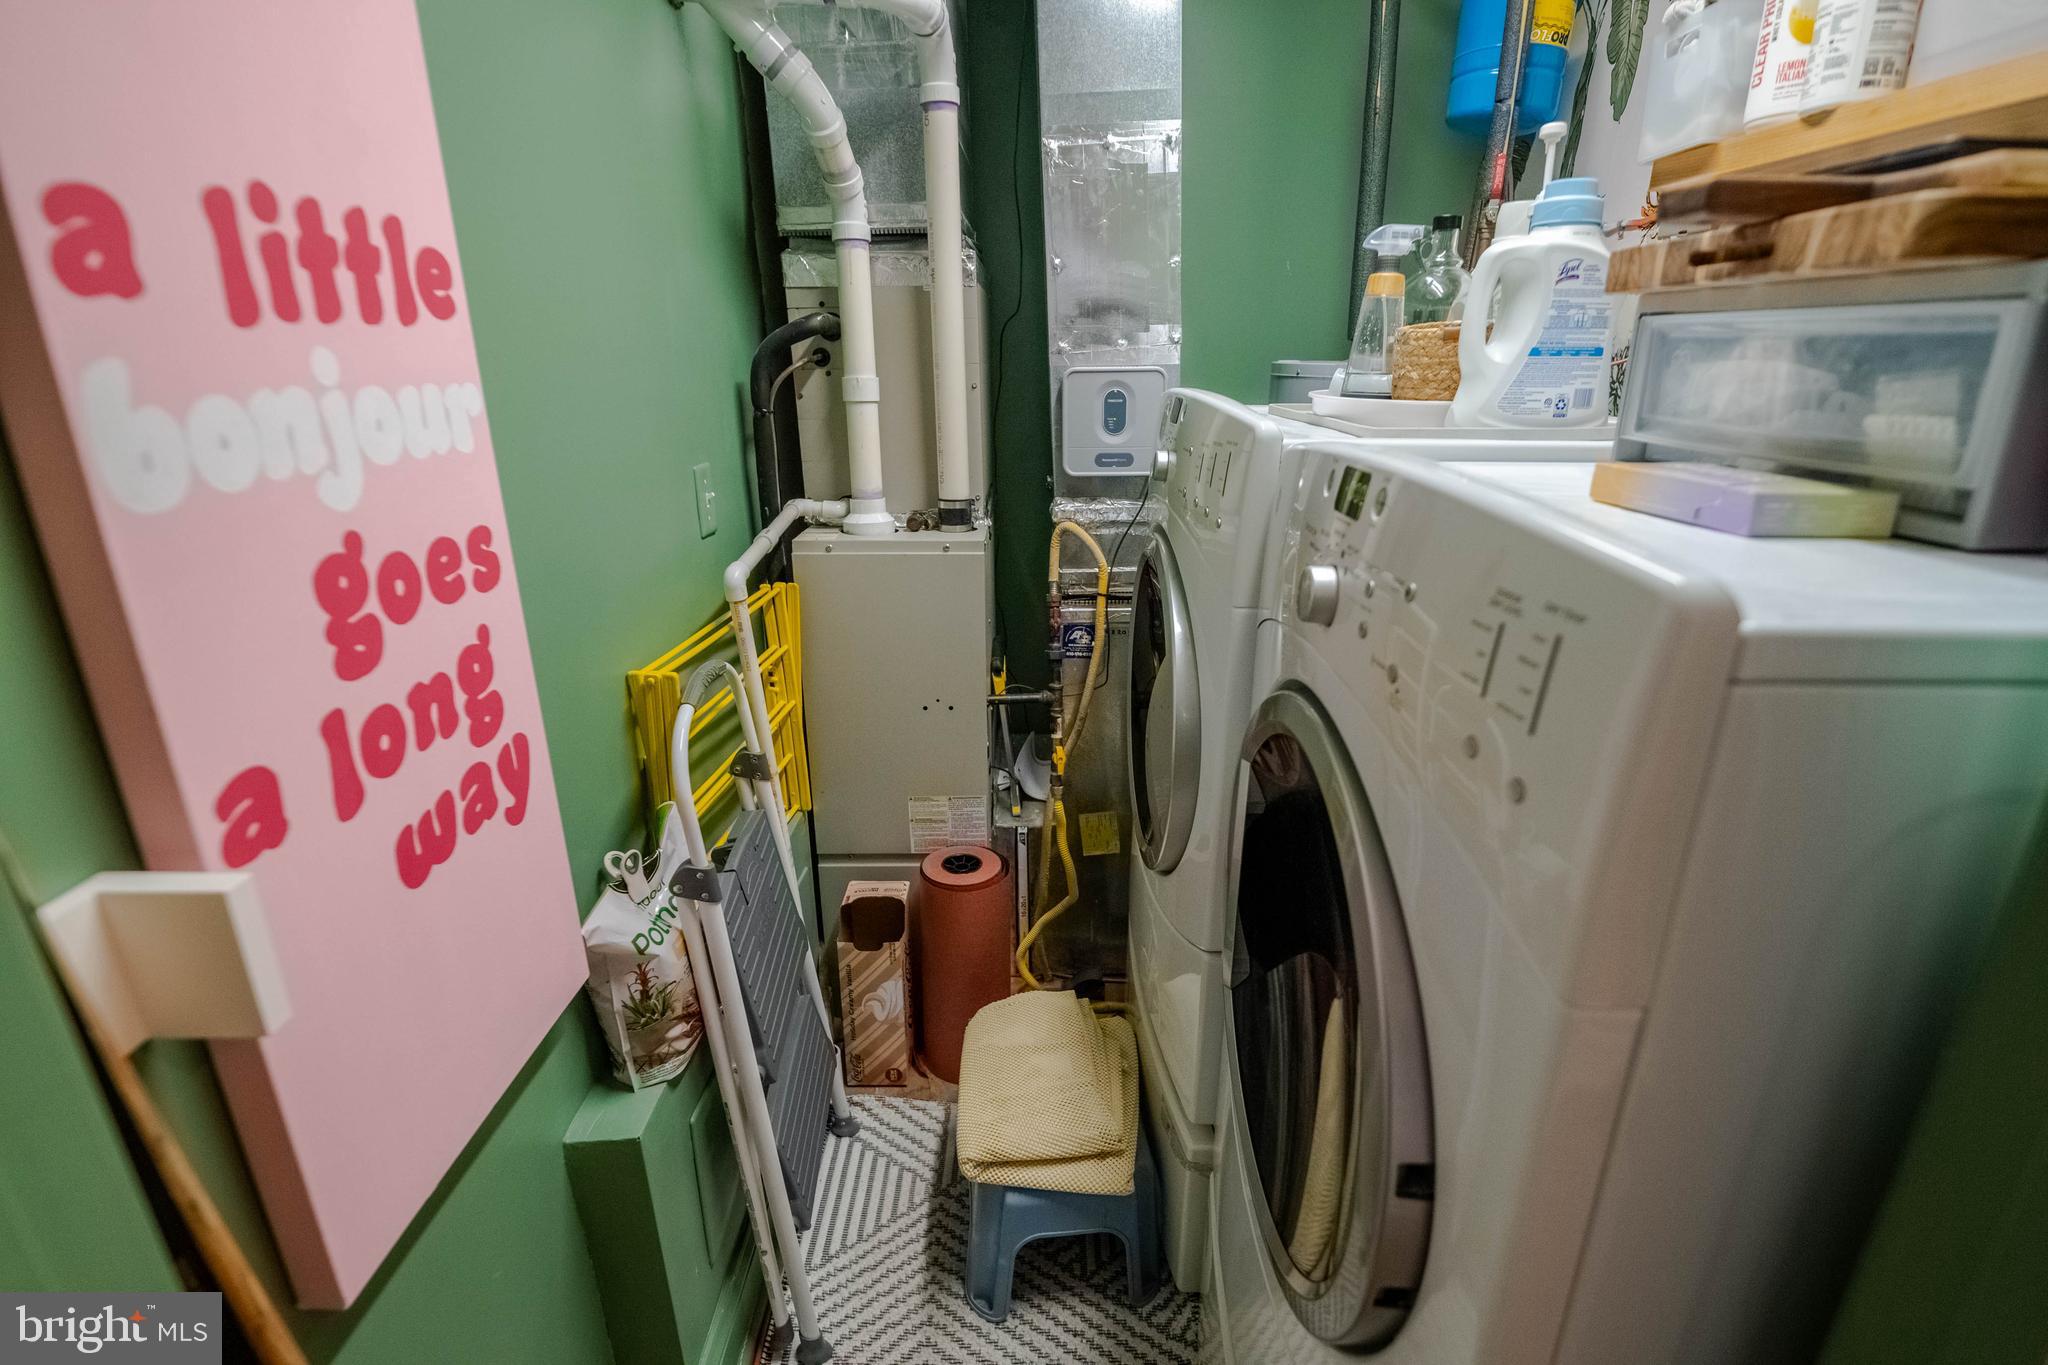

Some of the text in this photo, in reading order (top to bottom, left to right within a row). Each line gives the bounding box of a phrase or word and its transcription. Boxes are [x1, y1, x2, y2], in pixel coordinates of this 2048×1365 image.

[1751, 31, 1771, 89] CLEAR
[39, 179, 456, 328] a little
[80, 345, 482, 515] bonjour
[313, 524, 501, 682] goes
[215, 623, 504, 869] a long
[395, 732, 530, 889] way
